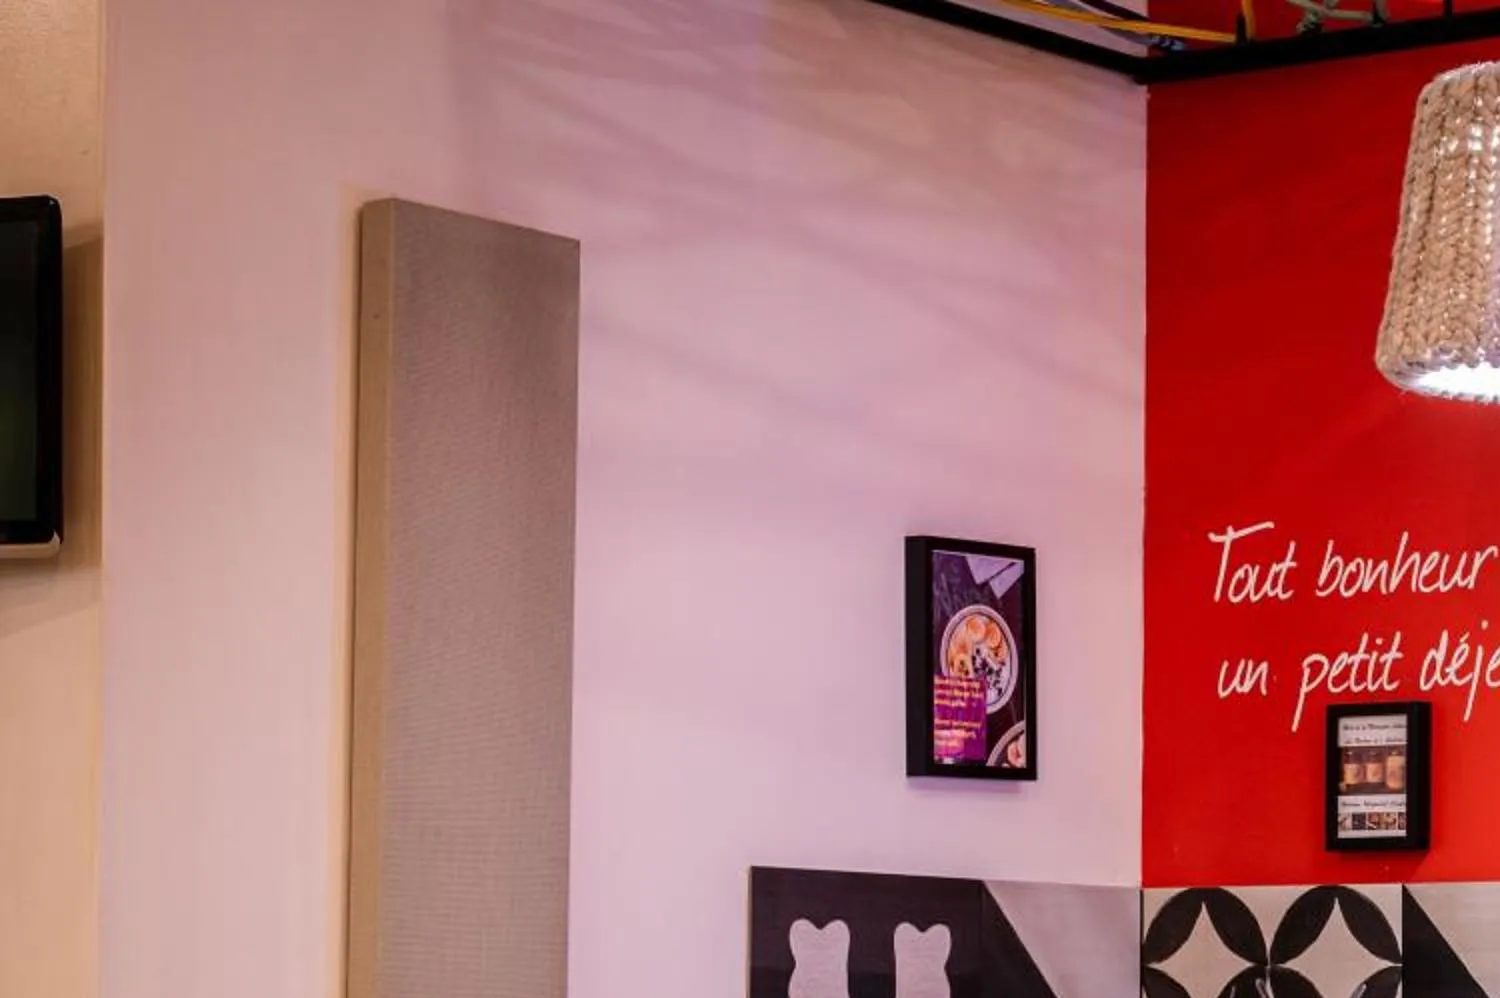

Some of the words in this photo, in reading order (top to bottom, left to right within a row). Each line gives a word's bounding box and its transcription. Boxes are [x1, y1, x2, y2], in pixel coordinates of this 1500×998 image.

[1208, 520, 1296, 603] Tout
[1315, 530, 1499, 598] bonheur
[1217, 658, 1270, 699] un
[1291, 631, 1404, 733] petit
